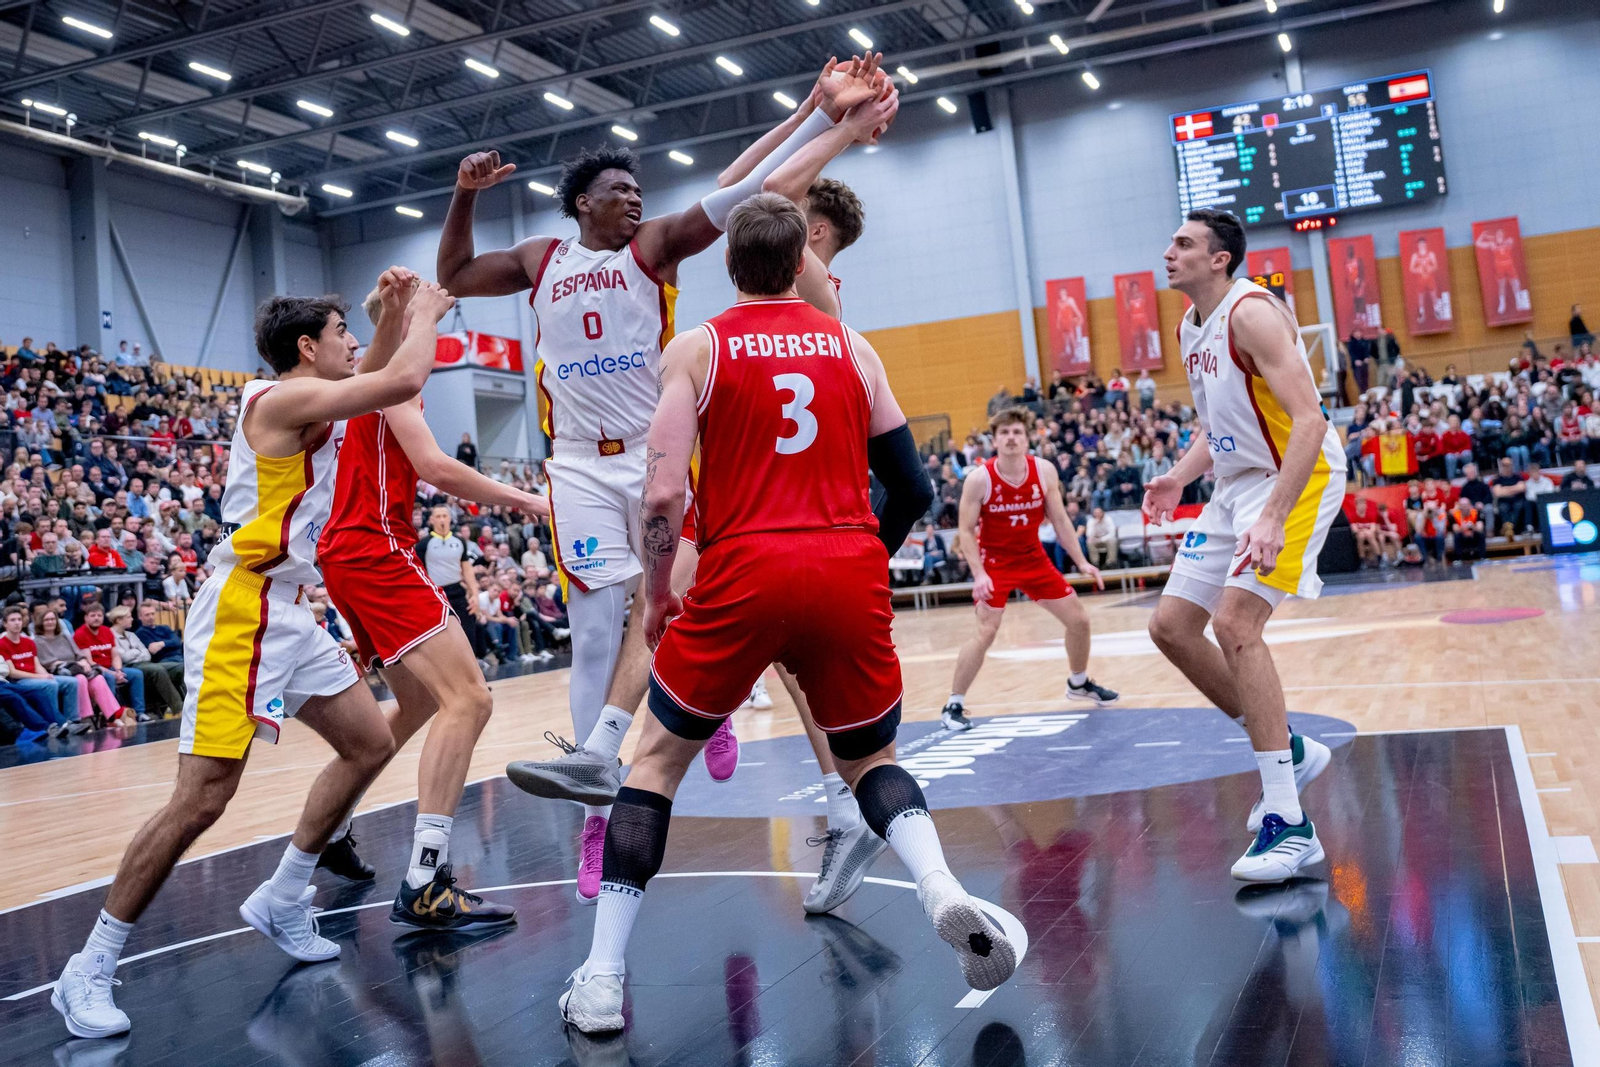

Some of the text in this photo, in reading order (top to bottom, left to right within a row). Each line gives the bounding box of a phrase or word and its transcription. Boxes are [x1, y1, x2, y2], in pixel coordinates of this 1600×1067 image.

[1282, 94, 1313, 111] 2:10
[552, 267, 628, 303] ESPAÑA
[583, 311, 603, 340] 0
[728, 333, 842, 360] PEDERSEN
[558, 351, 645, 380] endesa
[772, 372, 818, 455] 3
